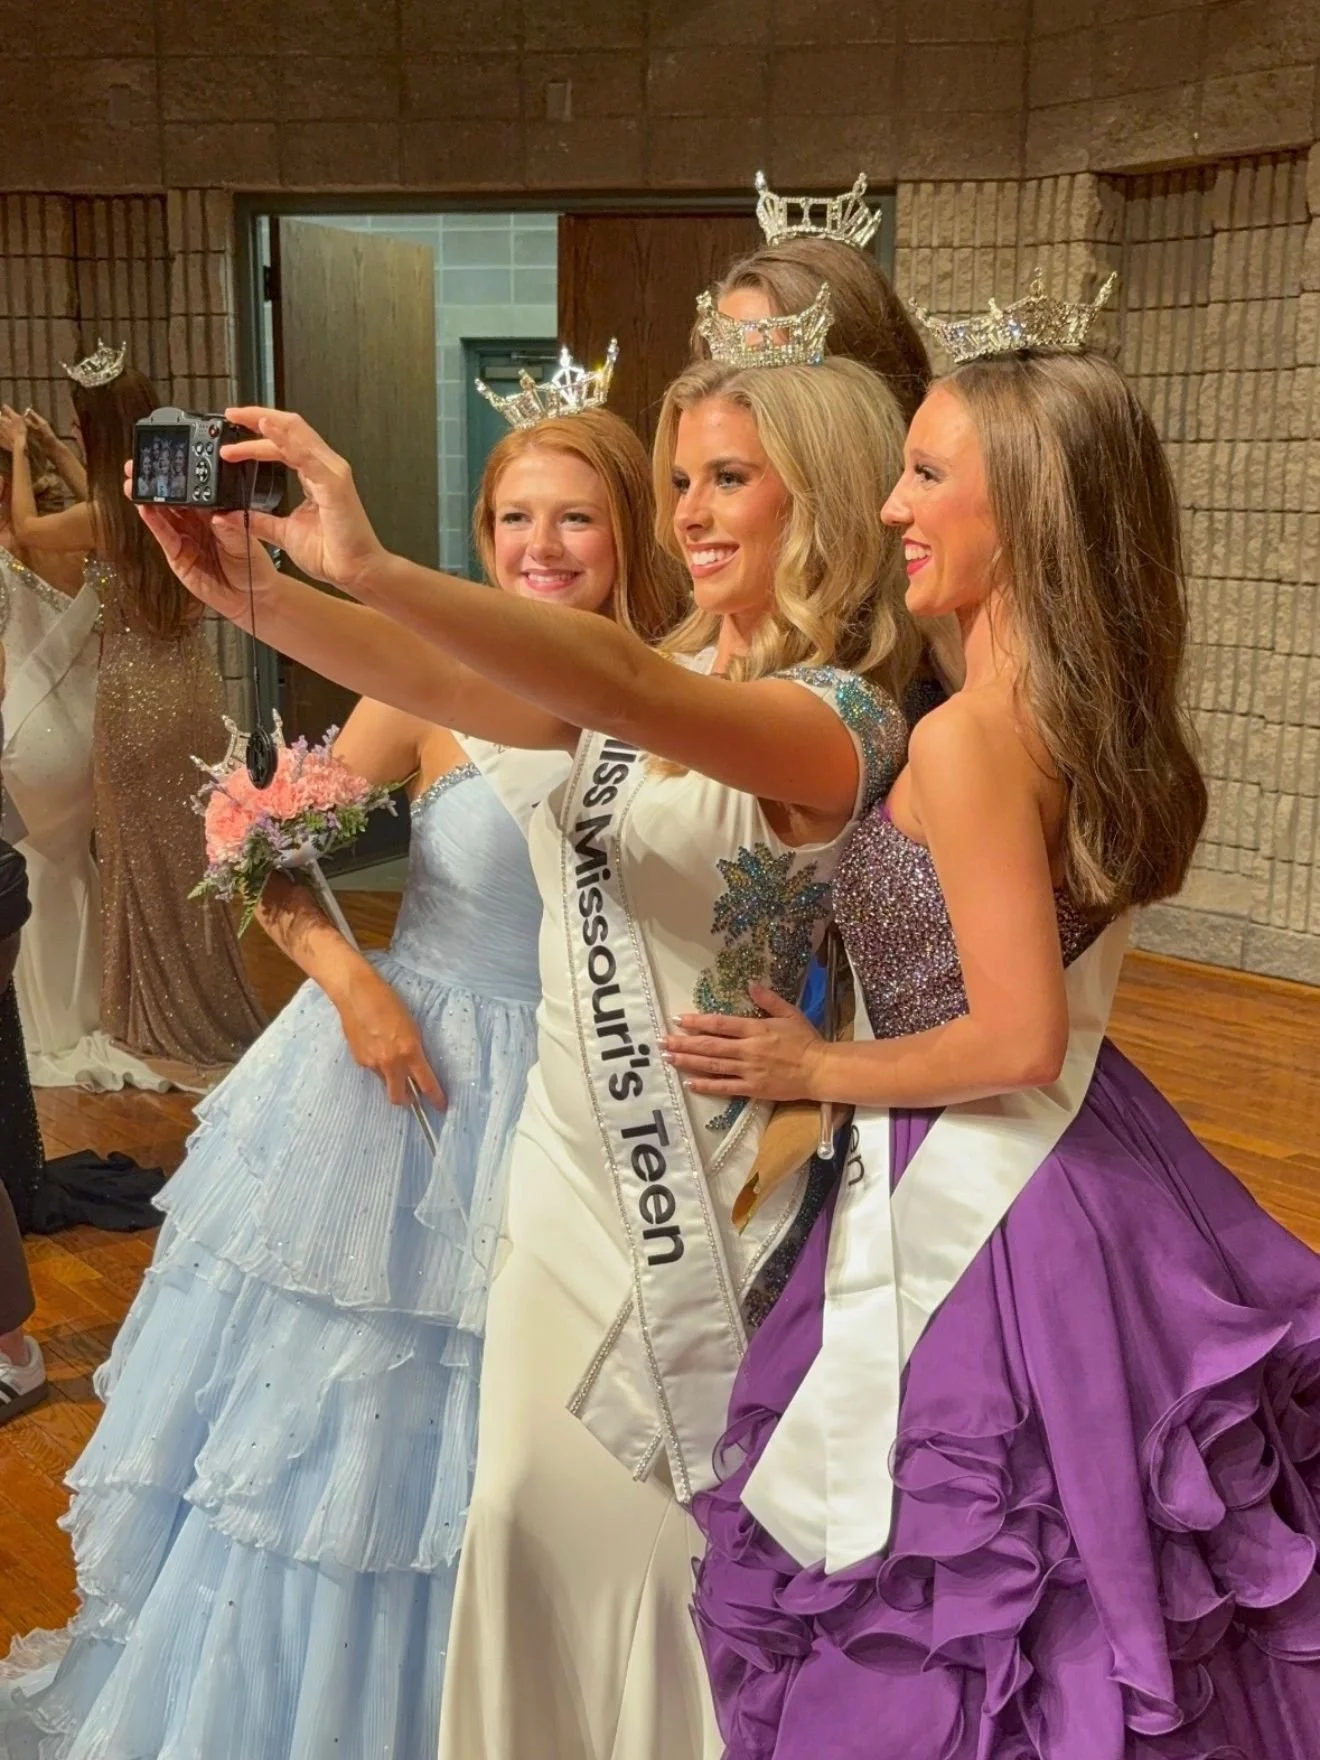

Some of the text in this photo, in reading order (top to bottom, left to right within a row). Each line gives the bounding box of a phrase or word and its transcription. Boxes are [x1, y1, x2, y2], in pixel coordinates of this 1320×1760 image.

[574, 738, 686, 1267] iss Missouri's Teen
